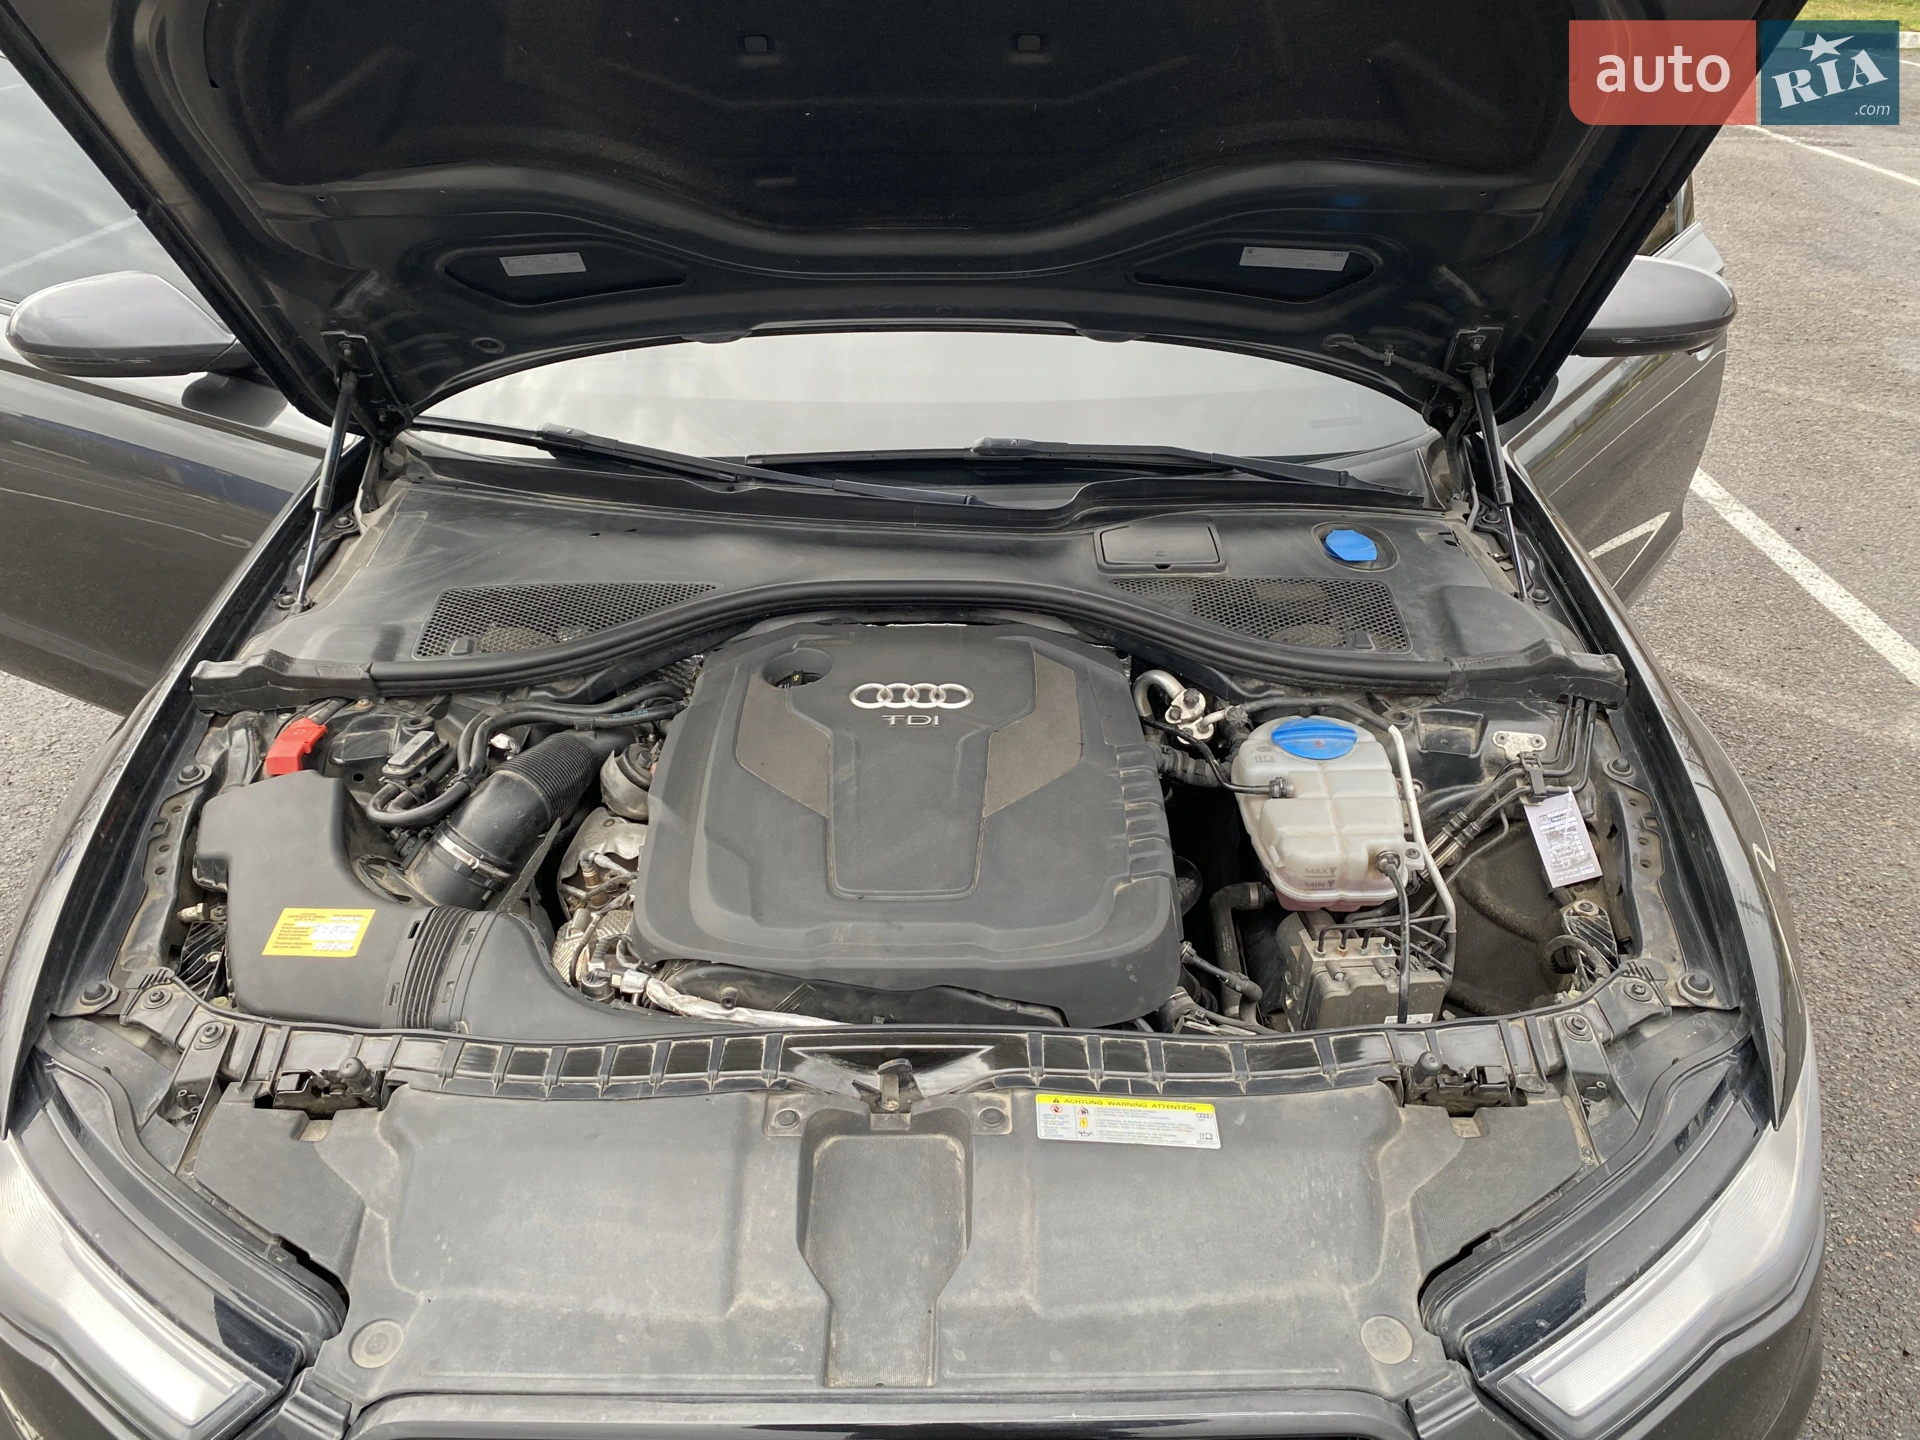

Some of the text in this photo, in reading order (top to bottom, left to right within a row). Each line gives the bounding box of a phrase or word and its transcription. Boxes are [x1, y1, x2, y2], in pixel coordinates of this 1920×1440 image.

[881, 714, 939, 727] TDI
[1063, 1098, 1104, 1106] ACHTUNG
[1151, 1103, 1197, 1111] ATTENTION
